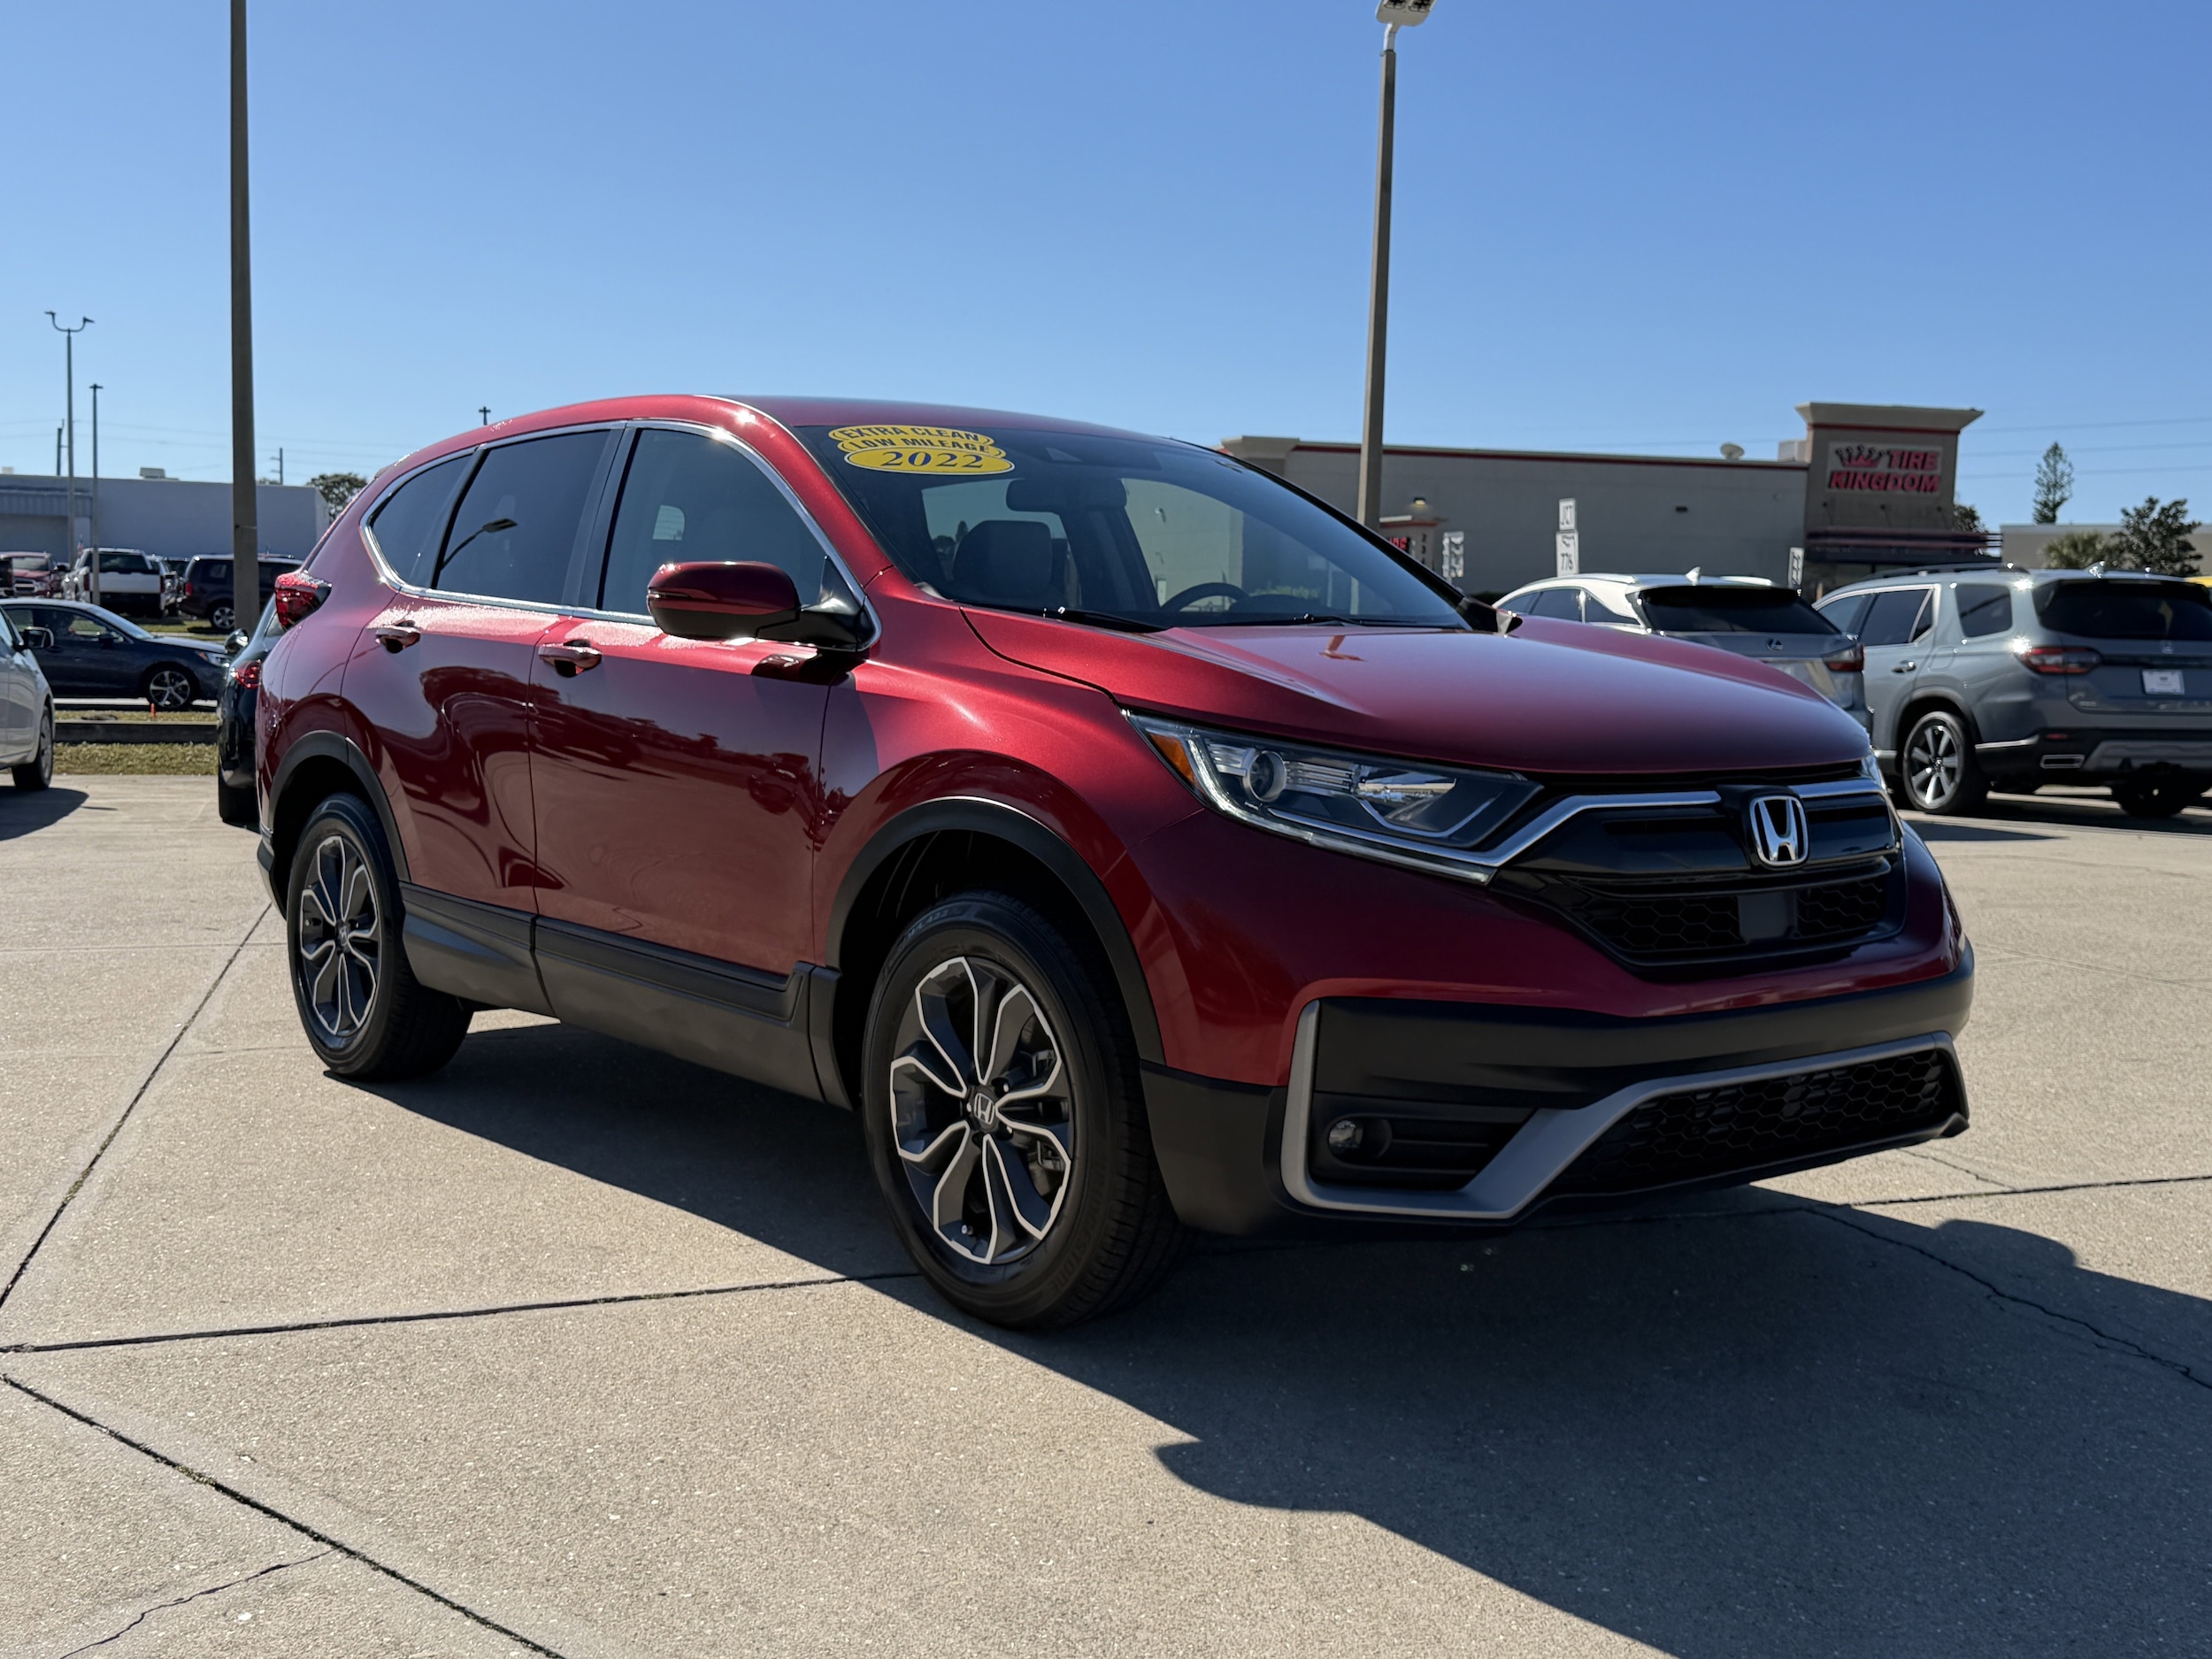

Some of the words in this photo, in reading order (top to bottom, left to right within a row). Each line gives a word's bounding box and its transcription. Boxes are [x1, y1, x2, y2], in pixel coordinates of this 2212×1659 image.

[840, 426, 909, 439] EXTRA
[911, 427, 979, 442] CLEAN
[849, 438, 895, 449] LOW
[901, 438, 989, 452] MILEAGE
[880, 451, 982, 469] 2022
[1888, 449, 1938, 470] TIRE
[1829, 472, 1940, 492] KINGDOM
